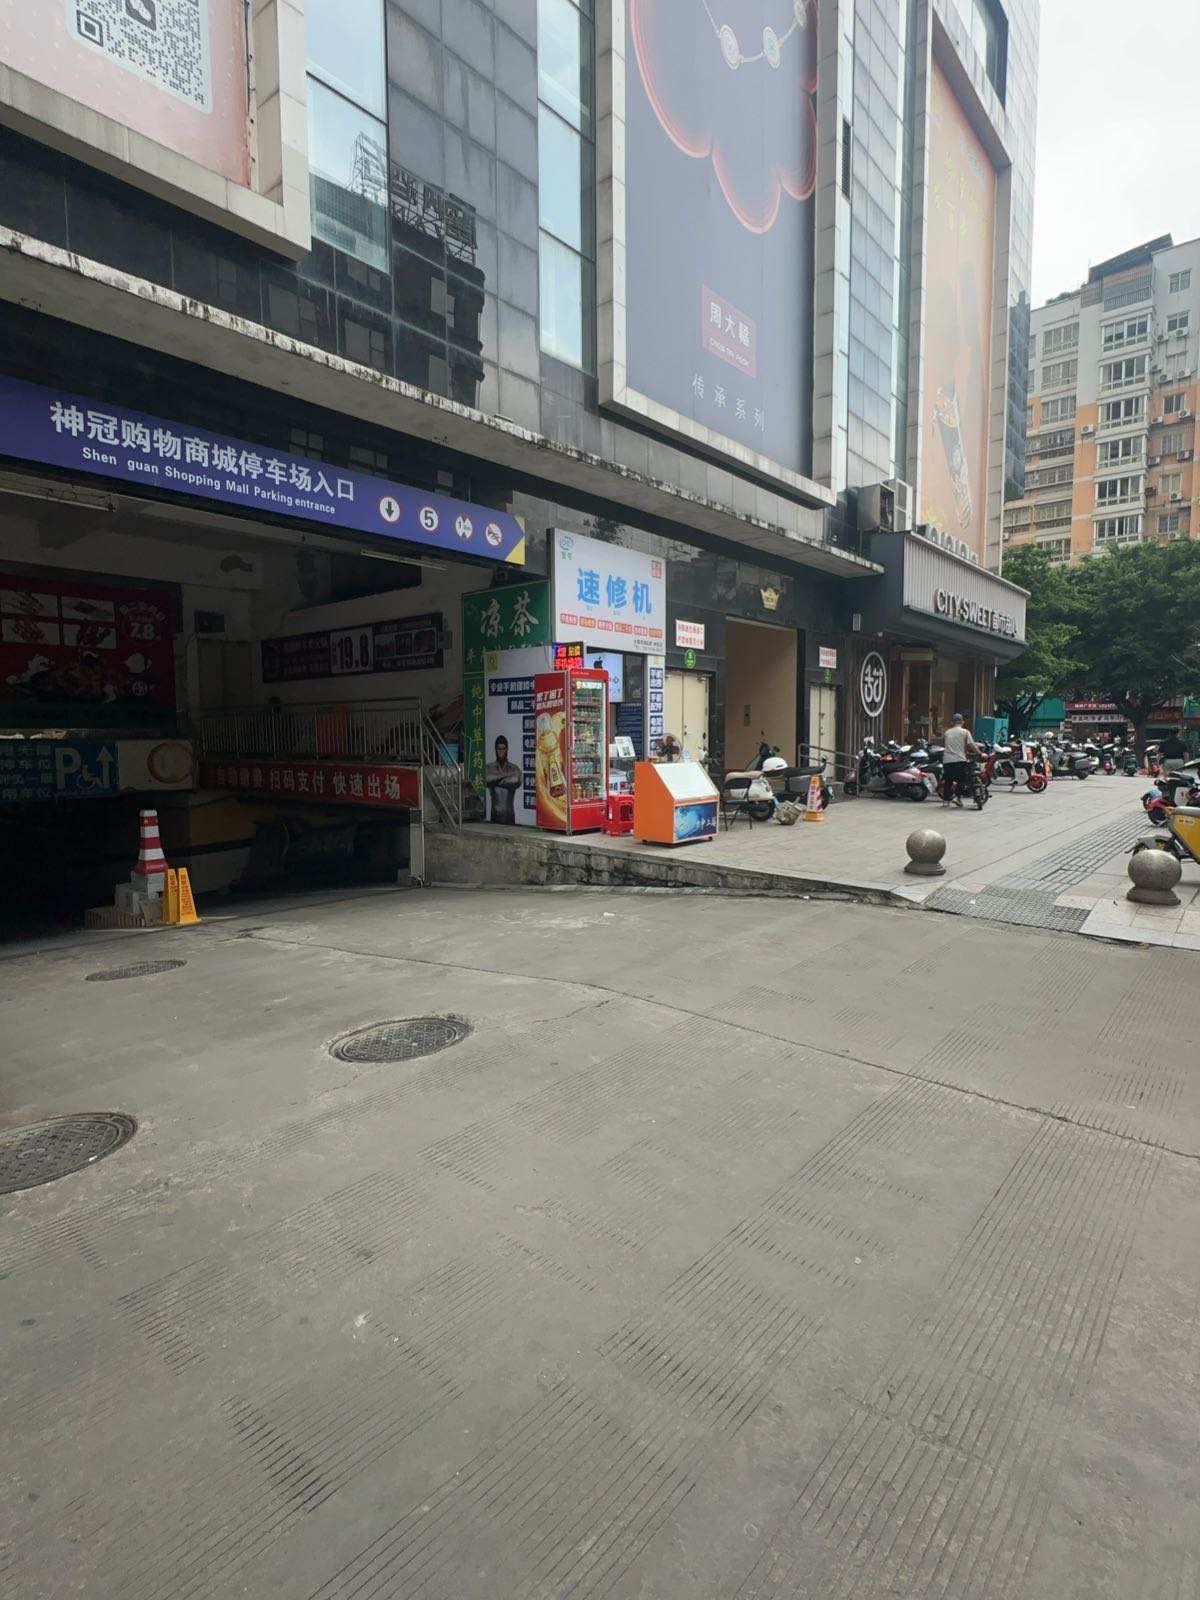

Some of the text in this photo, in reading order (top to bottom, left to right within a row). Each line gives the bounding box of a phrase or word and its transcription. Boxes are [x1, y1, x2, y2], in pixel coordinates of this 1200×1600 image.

[710, 302, 750, 347] 周大福
[692, 373, 766, 432] 传承系列
[49, 401, 356, 502] 神冠购物商城停车场入口
[82, 446, 336, 514] Shen guan Shopping Mall Parking entrance
[424, 510, 434, 528] 5
[576, 567, 653, 615] 速修机
[129, 623, 156, 640] 7.8
[479, 591, 540, 638] 凉茶
[336, 633, 370, 670] 19.8
[536, 687, 563, 704] 累了困了
[55, 747, 82, 791] P
[269, 768, 326, 794] 扫码支付
[333, 771, 401, 801] 快速出场
